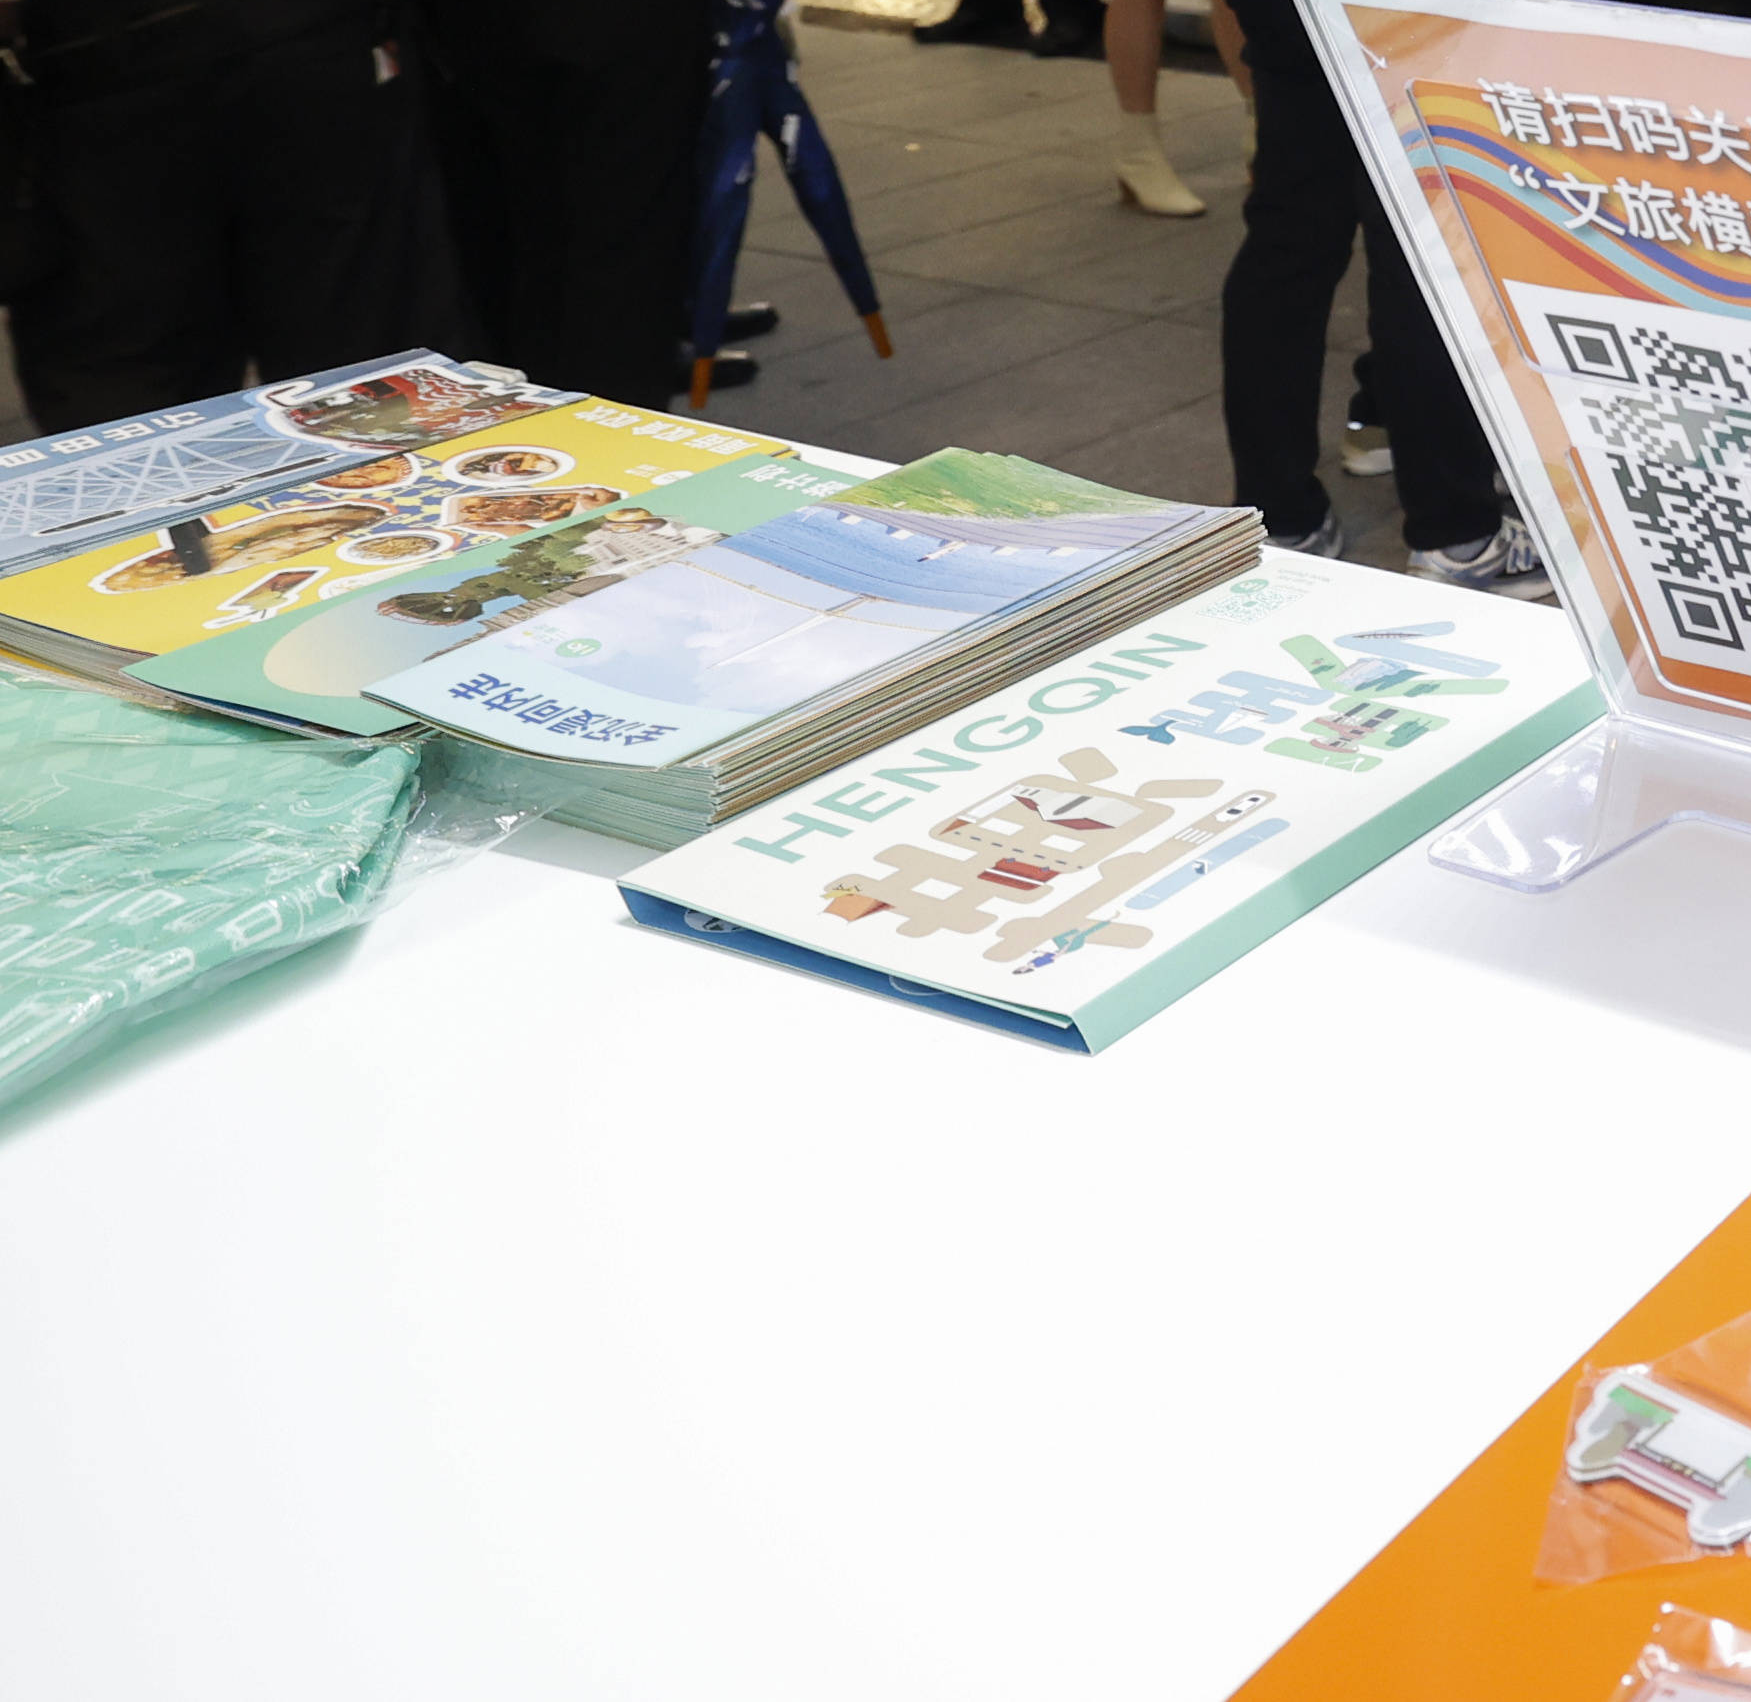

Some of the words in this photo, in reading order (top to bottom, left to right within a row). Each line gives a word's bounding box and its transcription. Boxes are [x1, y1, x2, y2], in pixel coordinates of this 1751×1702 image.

[448, 673, 680, 746] 全沉浸向内走
[733, 632, 1208, 864] HENGQIN
